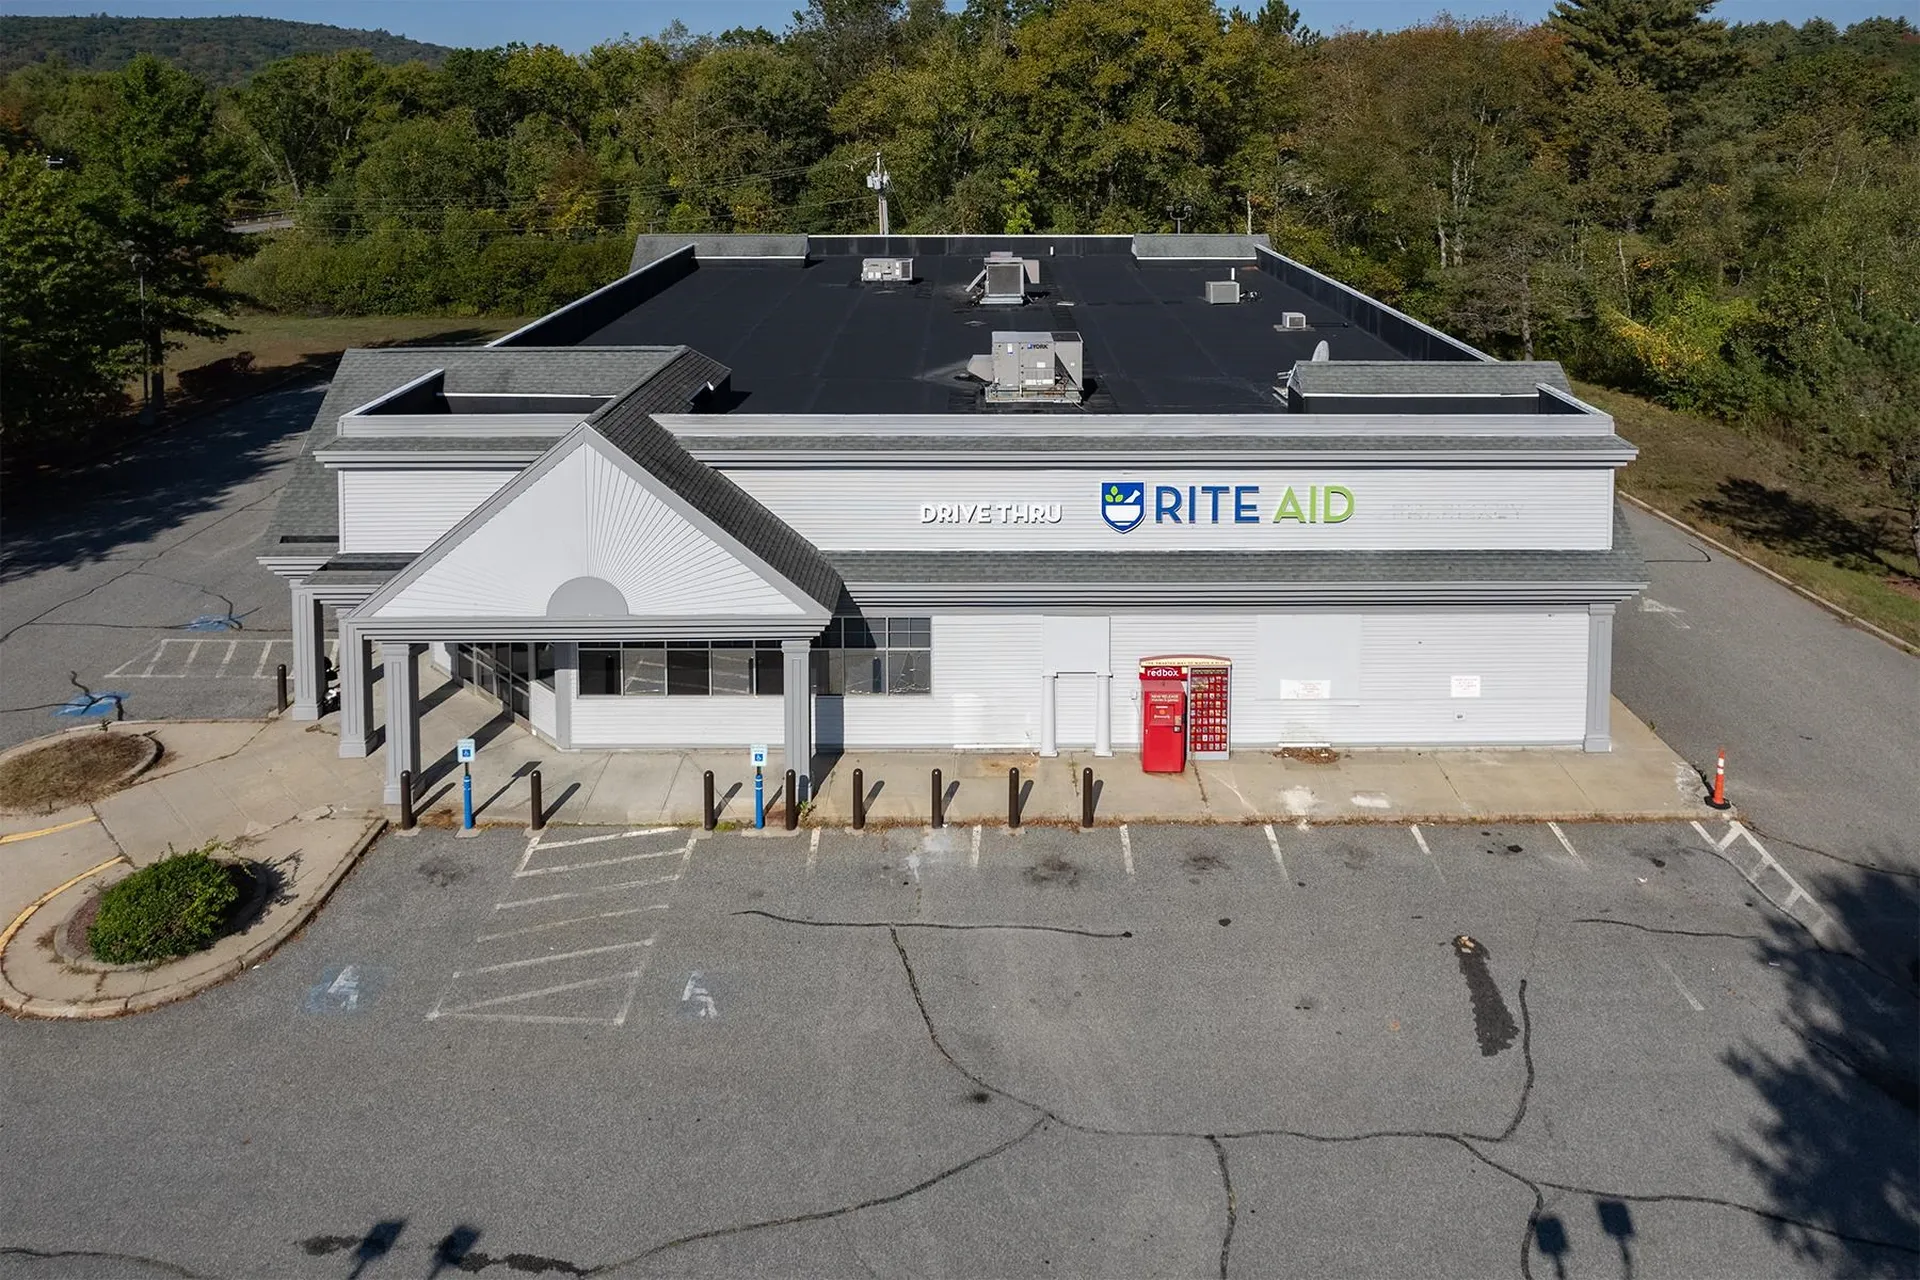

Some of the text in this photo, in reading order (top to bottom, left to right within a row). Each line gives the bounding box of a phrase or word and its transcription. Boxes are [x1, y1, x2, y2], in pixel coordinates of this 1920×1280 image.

[920, 502, 1063, 524] DRIVE THRU
[1155, 485, 1261, 524] RITE
[1272, 485, 1356, 524] AID
[1147, 669, 1179, 677] redbox
